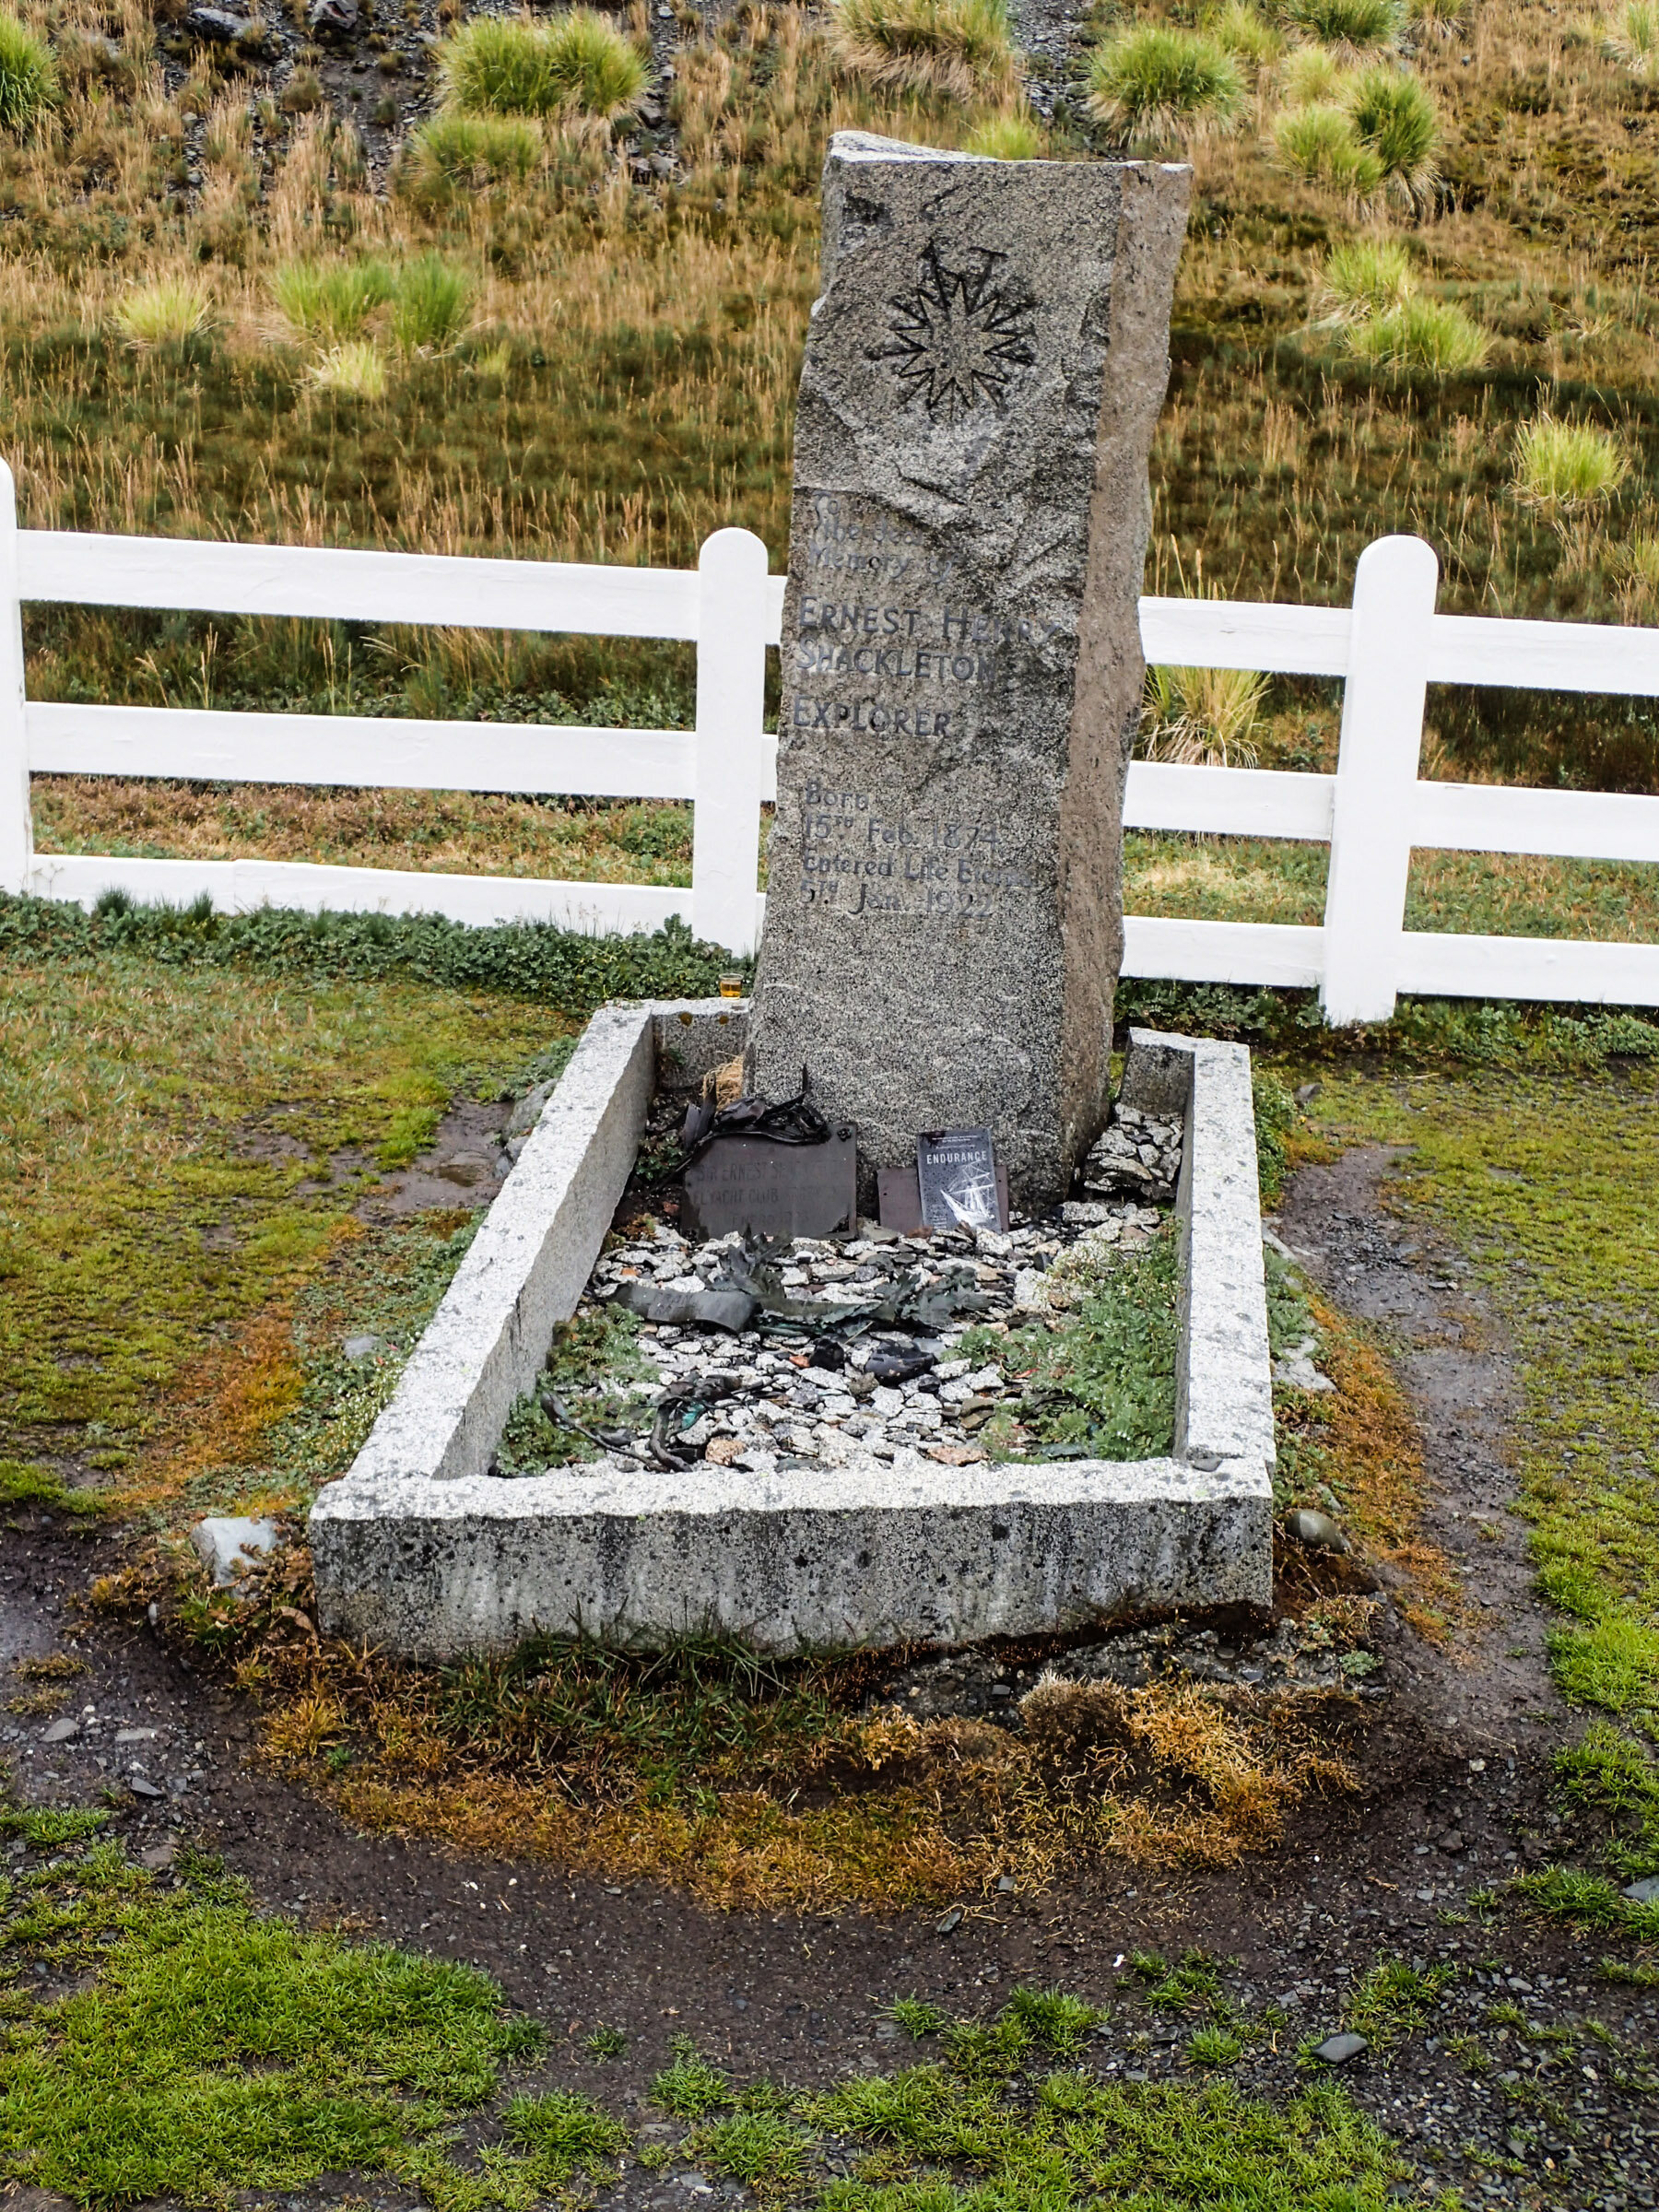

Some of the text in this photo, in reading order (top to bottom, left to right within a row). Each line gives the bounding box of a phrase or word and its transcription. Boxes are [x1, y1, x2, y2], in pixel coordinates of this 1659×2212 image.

[872, 516, 923, 547] dea
[809, 542, 913, 579] Memory
[799, 595, 919, 636] ERNEST
[796, 636, 996, 689] SHACKLETON
[793, 695, 951, 736] EXPLORER
[806, 780, 868, 810] Born
[933, 822, 1001, 852] 1874
[802, 846, 1034, 888] Entered Life Eterna
[926, 888, 994, 917] 1922
[926, 1151, 988, 1165] ENDURANCE
